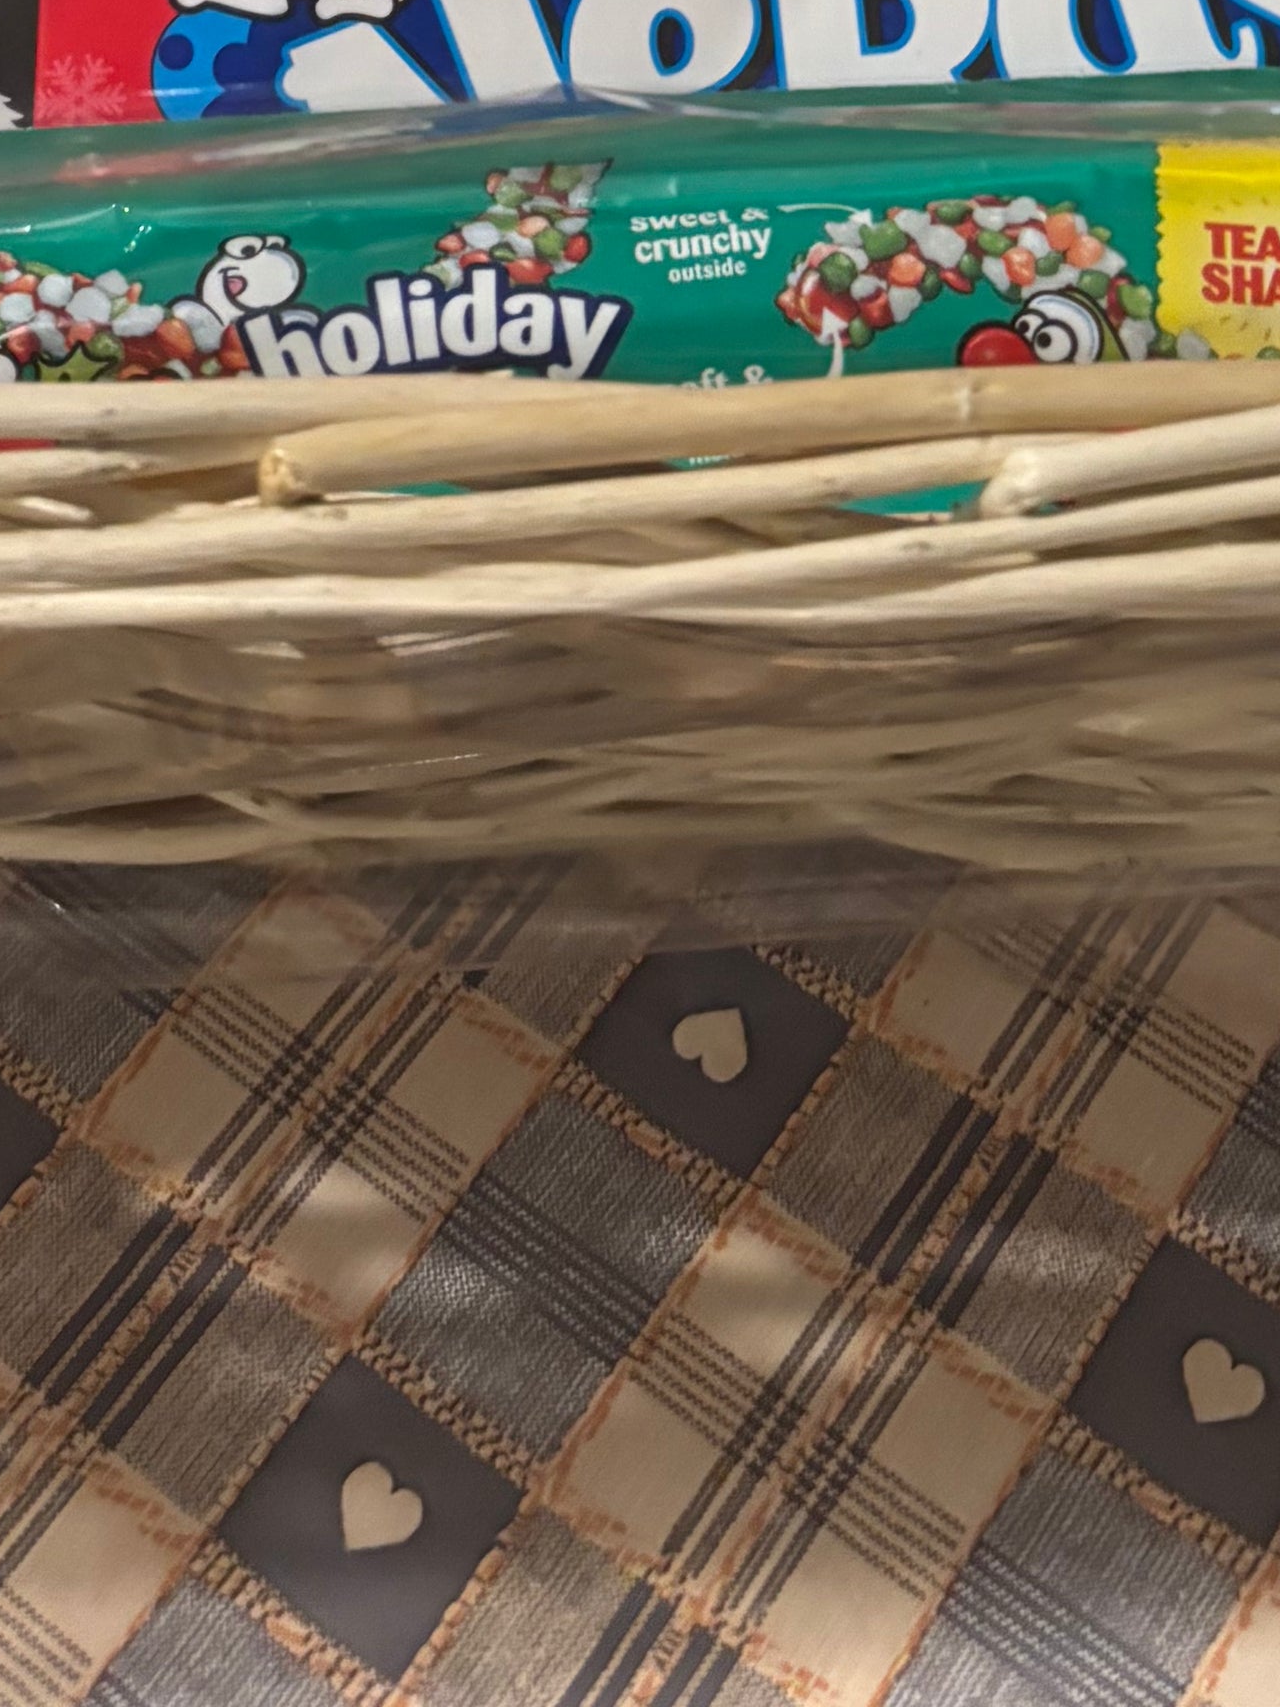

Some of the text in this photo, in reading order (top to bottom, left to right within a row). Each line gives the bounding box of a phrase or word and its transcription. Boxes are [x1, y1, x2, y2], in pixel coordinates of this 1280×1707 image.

[630, 206, 769, 233] sweet &
[634, 223, 772, 264] crunchy
[668, 256, 748, 284] outside
[244, 267, 622, 379] holiday
